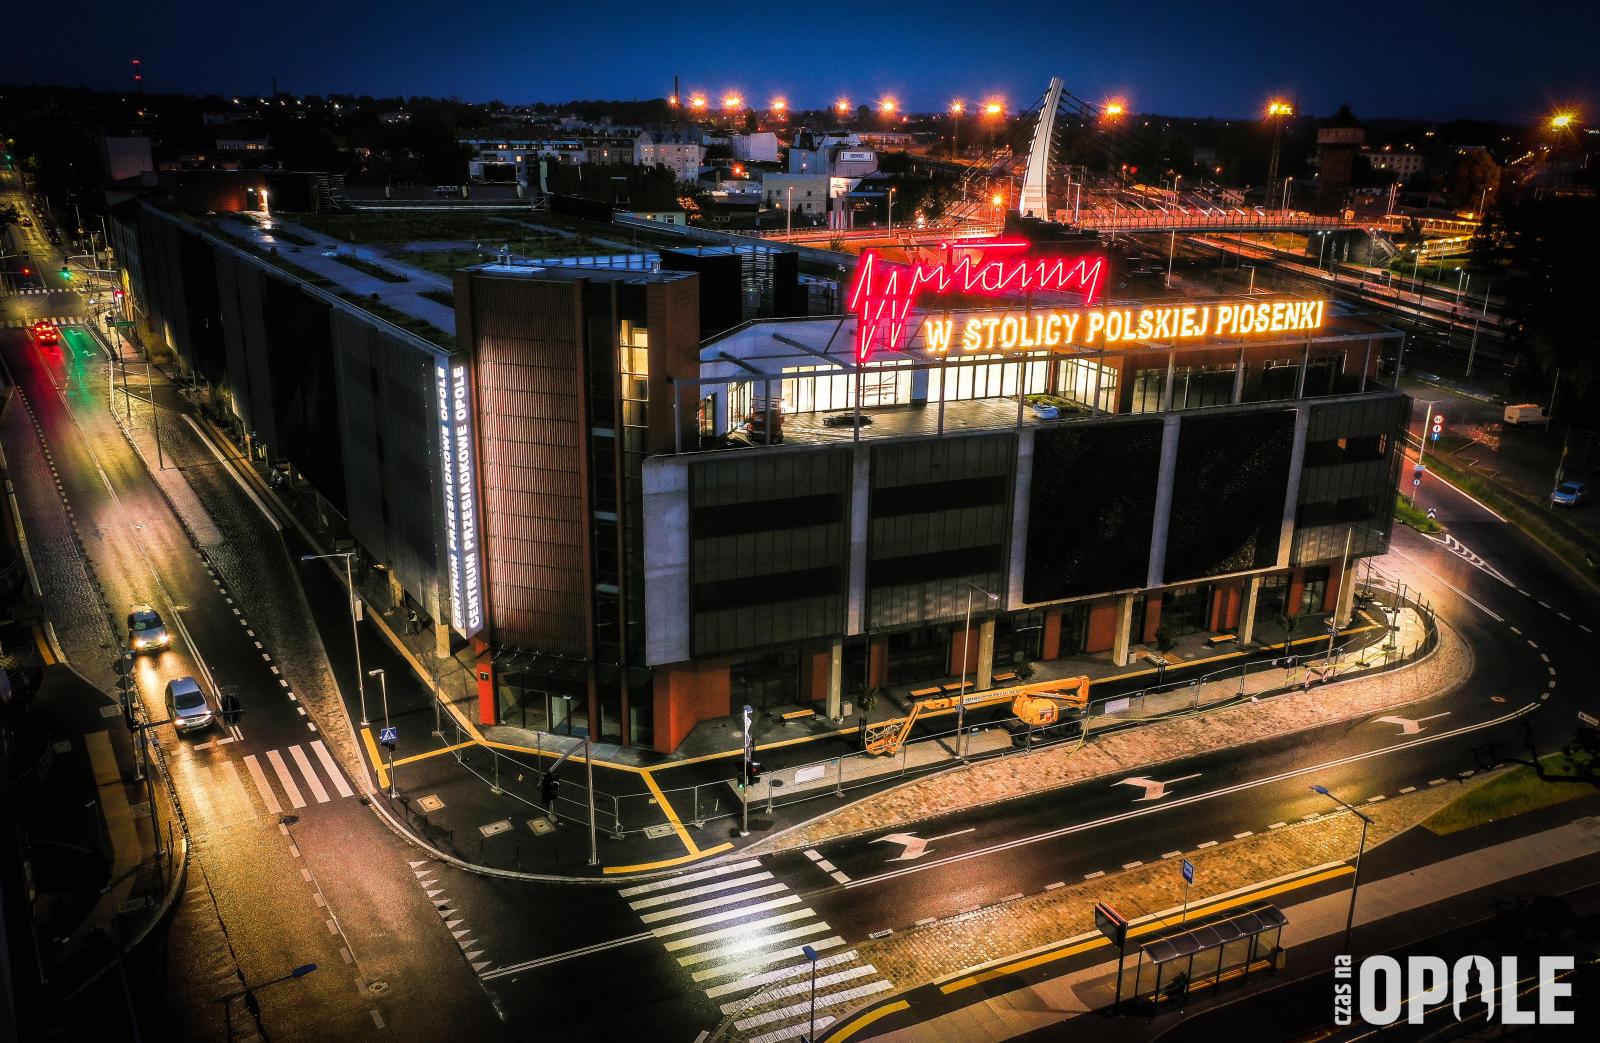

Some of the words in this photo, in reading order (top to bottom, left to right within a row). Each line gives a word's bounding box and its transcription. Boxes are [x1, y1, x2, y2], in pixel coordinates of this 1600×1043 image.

[851, 241, 1102, 360] Witamy
[924, 319, 953, 352] W
[962, 312, 1081, 350] STOLICY
[1085, 306, 1209, 343] POLSKIEJ
[1215, 300, 1324, 335] PIOSENKI
[437, 366, 449, 421] OPOLE
[452, 365, 467, 421] OPOLE
[442, 425, 457, 552] PRZESIADKOWE
[456, 424, 474, 551] PRZESIADKOWE
[450, 553, 462, 629] CENTRUM
[464, 552, 480, 629] CENTRUM
